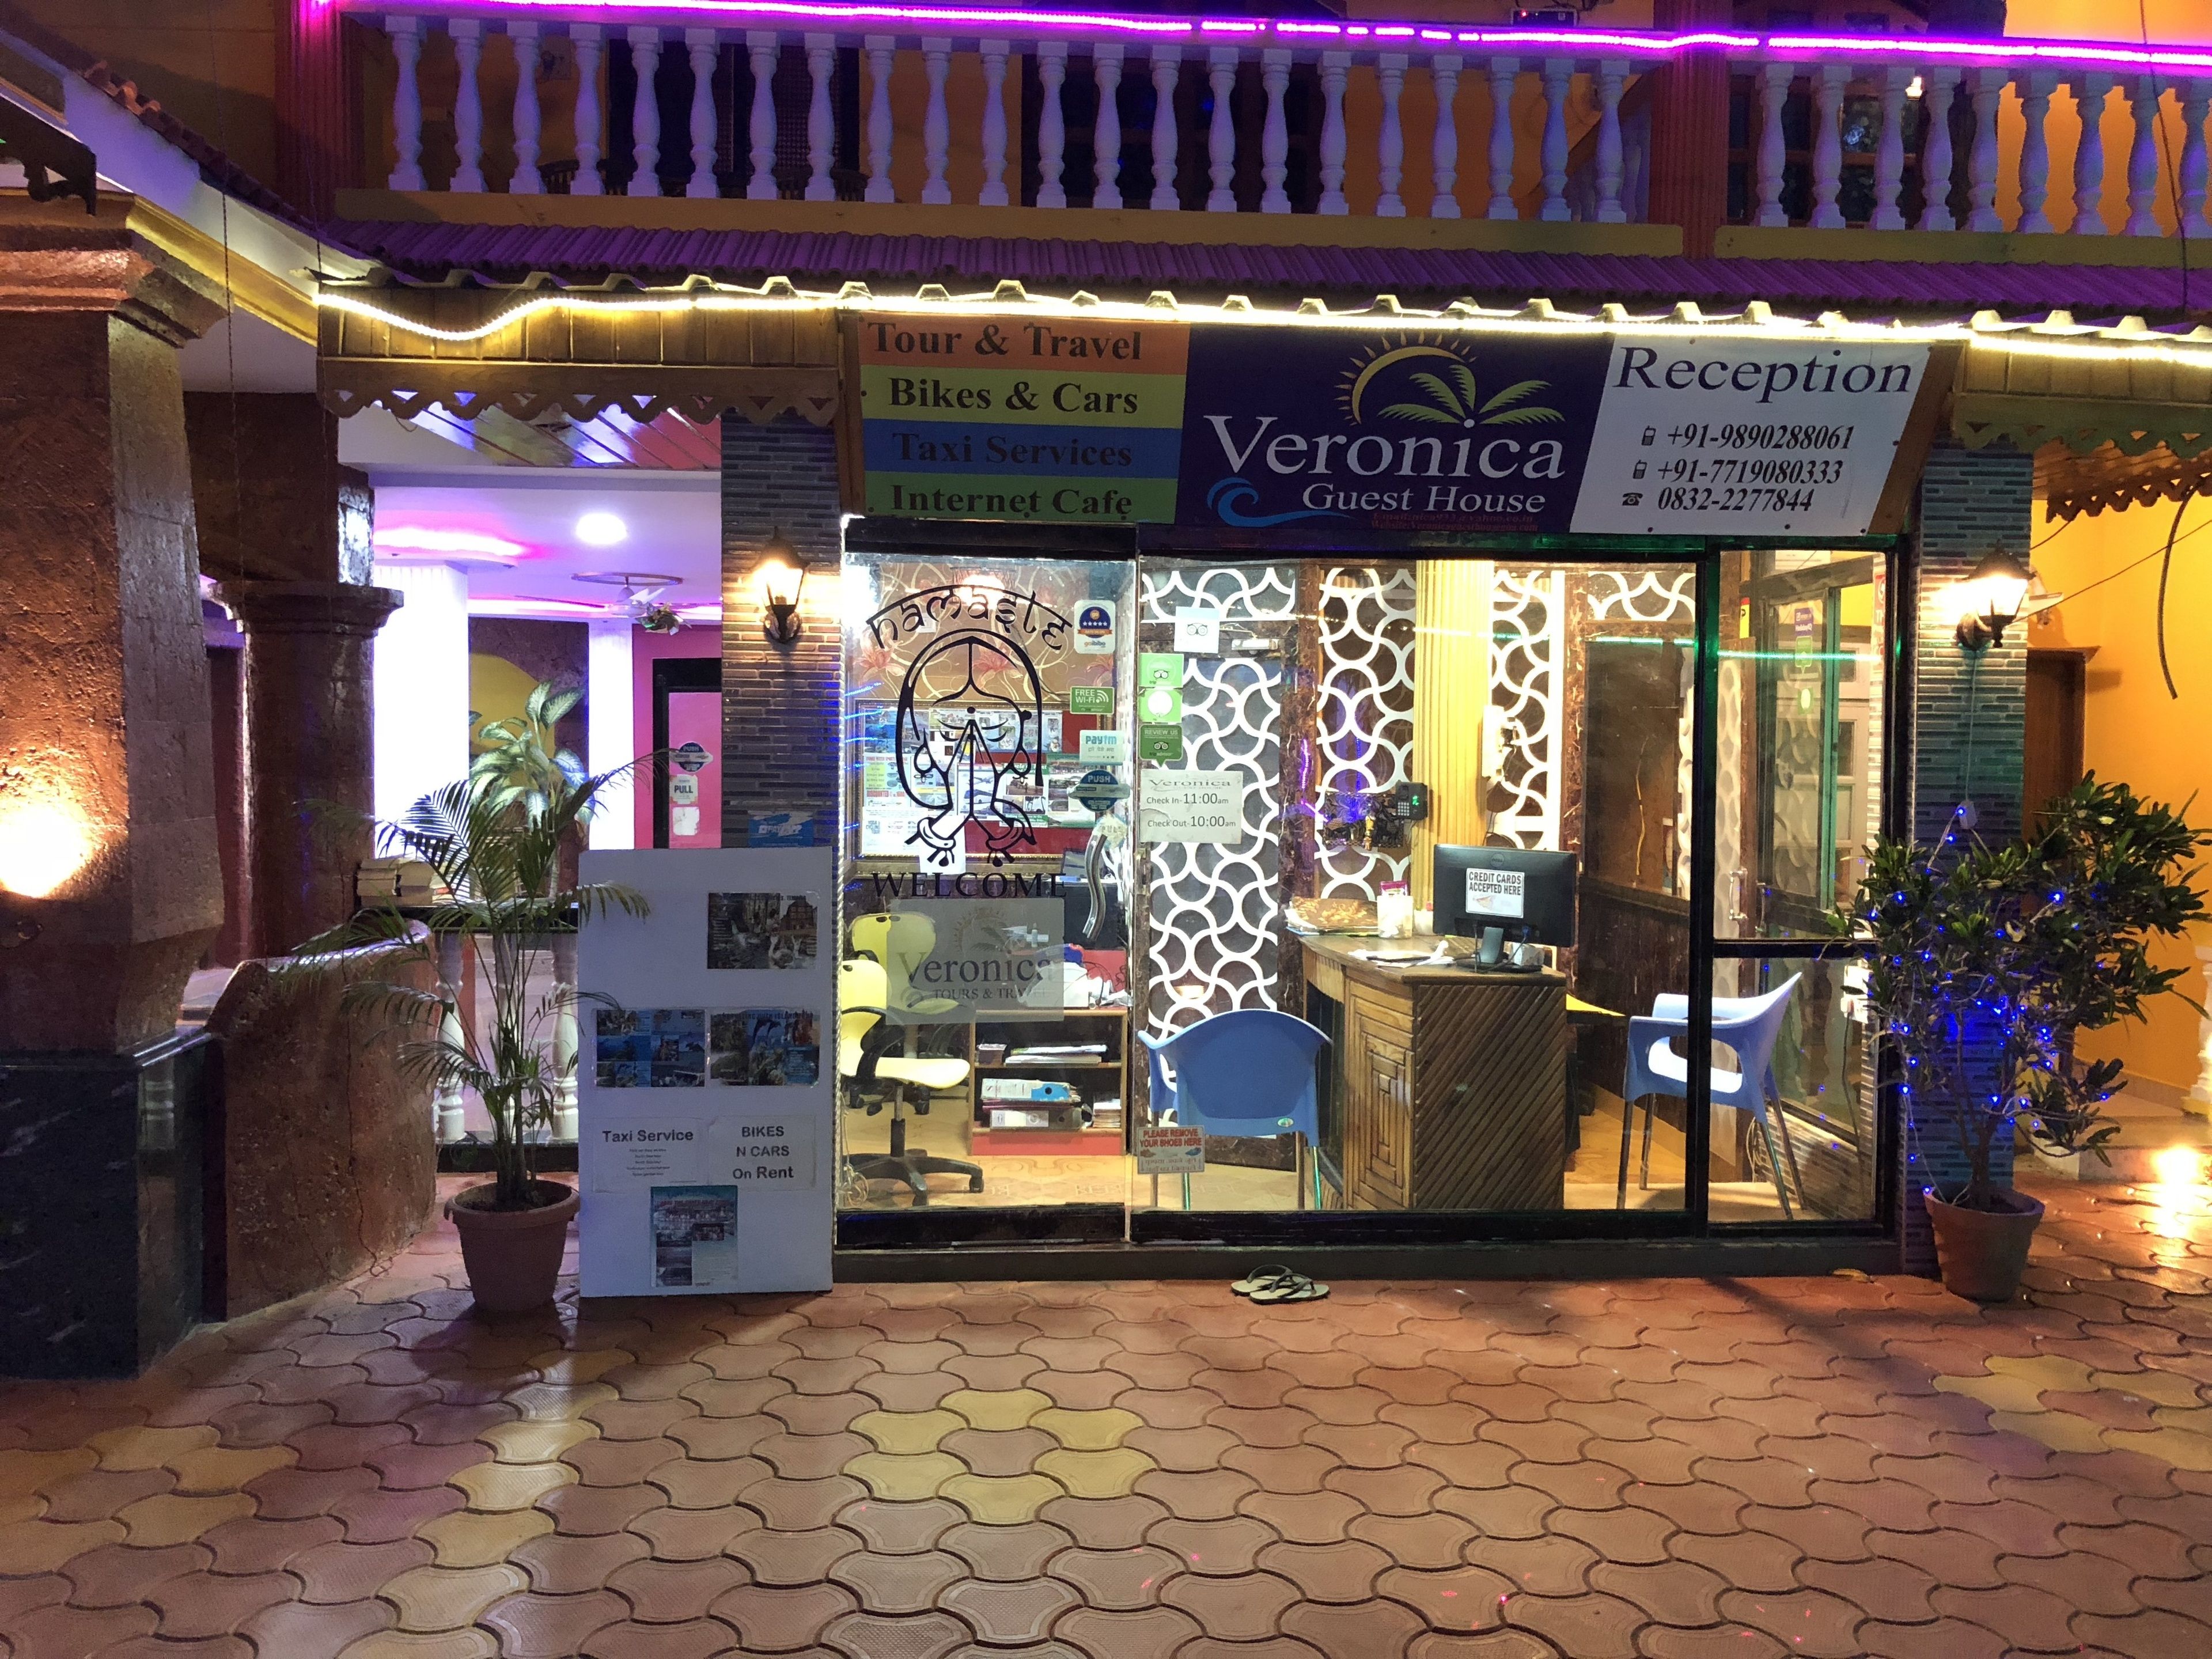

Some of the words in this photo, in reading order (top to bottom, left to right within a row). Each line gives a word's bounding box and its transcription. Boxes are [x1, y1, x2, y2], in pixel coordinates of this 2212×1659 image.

[868, 322, 963, 354] Tour
[975, 324, 1010, 355] &
[1023, 324, 1142, 360] Travel
[1612, 347, 1911, 403] Reception
[888, 378, 991, 410] Bikes
[1005, 381, 1039, 411] &
[1052, 382, 1138, 414] Cars
[1203, 415, 1566, 479] Veronica
[1667, 423, 1855, 449] +91-9890288061
[892, 433, 972, 462] Taxi
[986, 435, 1132, 467] Services
[1657, 459, 1843, 484] +91-7719080333
[891, 484, 1041, 514] Internet
[1052, 488, 1132, 515] Cafe
[1302, 483, 1414, 511] Guest
[1423, 486, 1546, 513] House
[1657, 487, 1815, 512] 0832-2277844
[675, 785, 693, 793] PULL
[871, 872, 1066, 897] WELCOME
[1469, 872, 1494, 883] CREDIT
[1496, 873, 1521, 885] CARDS
[1469, 882, 1502, 894] ACCEPTED
[1504, 885, 1521, 895] HERE
[934, 988, 979, 999] TOURS
[983, 988, 993, 999] &
[603, 1130, 632, 1142] Taxi
[637, 1129, 694, 1142] Service
[742, 1126, 784, 1138] BIKES
[1140, 1139, 1158, 1147] YOUR
[1160, 1138, 1182, 1147] SHOES
[1184, 1137, 1202, 1146] HERE
[1143, 1130, 1169, 1138] PLEASE
[1170, 1128, 1198, 1137] REMOVE
[736, 1146, 745, 1157] N
[751, 1145, 789, 1157] CARS
[733, 1168, 751, 1179] On
[756, 1166, 794, 1179] Rent
